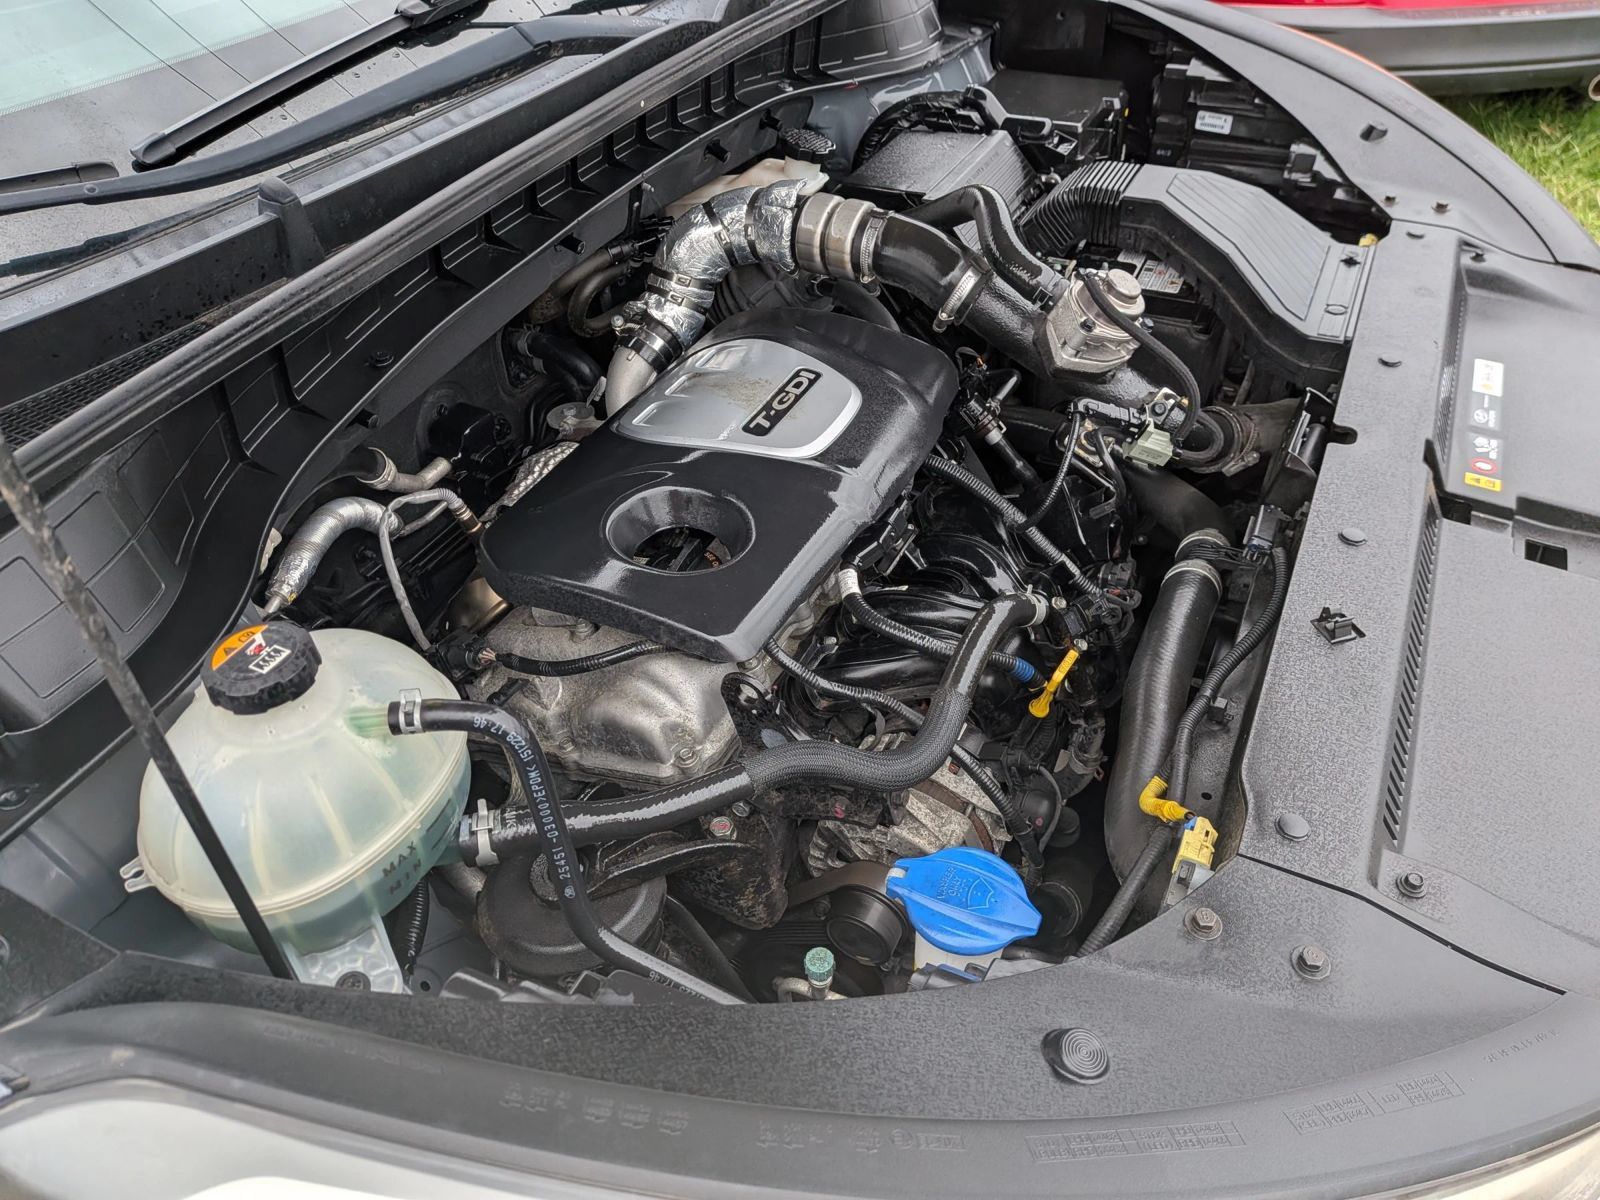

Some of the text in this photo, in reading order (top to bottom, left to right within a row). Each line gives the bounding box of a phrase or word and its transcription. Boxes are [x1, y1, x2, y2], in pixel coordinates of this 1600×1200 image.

[473, 716, 506, 735] 17:46
[506, 731, 535, 762] 151229
[382, 840, 417, 877] MAX
[389, 858, 422, 896] MIN
